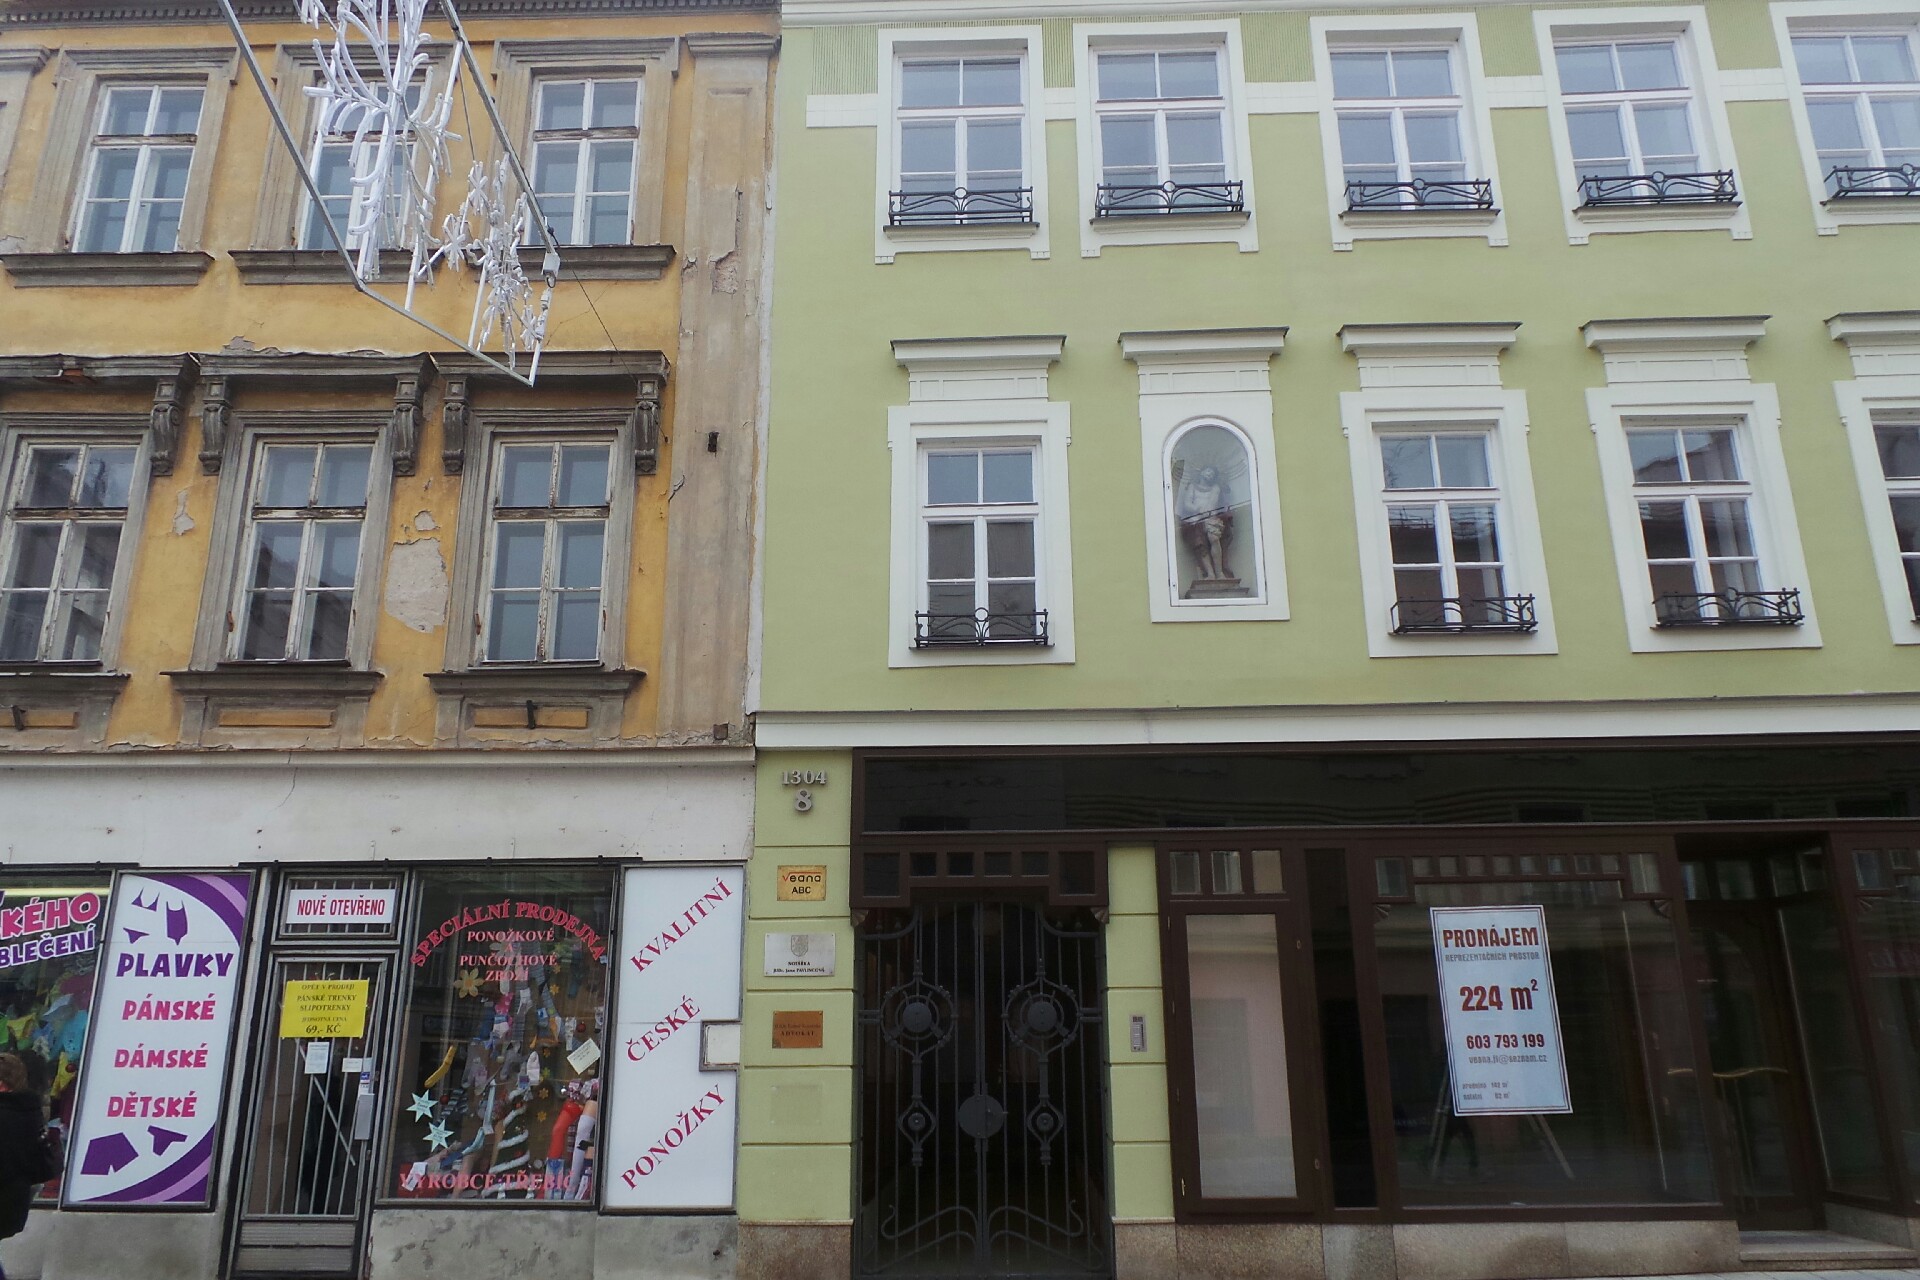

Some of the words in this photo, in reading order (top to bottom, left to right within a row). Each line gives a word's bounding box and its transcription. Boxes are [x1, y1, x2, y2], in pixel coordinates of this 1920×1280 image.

[782, 769, 826, 785] 1304
[794, 788, 813, 812] 8
[791, 886, 811, 894] ABC
[297, 894, 327, 916] NOVĚ
[329, 894, 386, 916] OTEVŘENO
[410, 898, 511, 968] SPECIÁLNÍ
[515, 901, 606, 961] PRODEJNA
[467, 928, 555, 942] PONOŽKOVÉ
[630, 876, 733, 972] KVALITNÍ
[1442, 924, 1539, 948] PRONÁJEM
[116, 952, 234, 978] PLAVKY
[460, 952, 558, 966] PUNČOCHOVÉ
[1445, 952, 1507, 962] REPREZENTAČNÍCH
[1509, 951, 1540, 960] PROSTOR
[122, 993, 216, 1020] PÁNSKÉ
[1460, 985, 1503, 1011] 224
[626, 995, 700, 1062] ČESKÉ
[1466, 1035, 1490, 1049] 603
[1494, 1034, 1518, 1049] 793
[1522, 1033, 1545, 1048] 199
[114, 1043, 208, 1068] DÁMSKÉ
[107, 1090, 197, 1117] DĚTSKÉ
[621, 1084, 725, 1190] PONOŽKY
